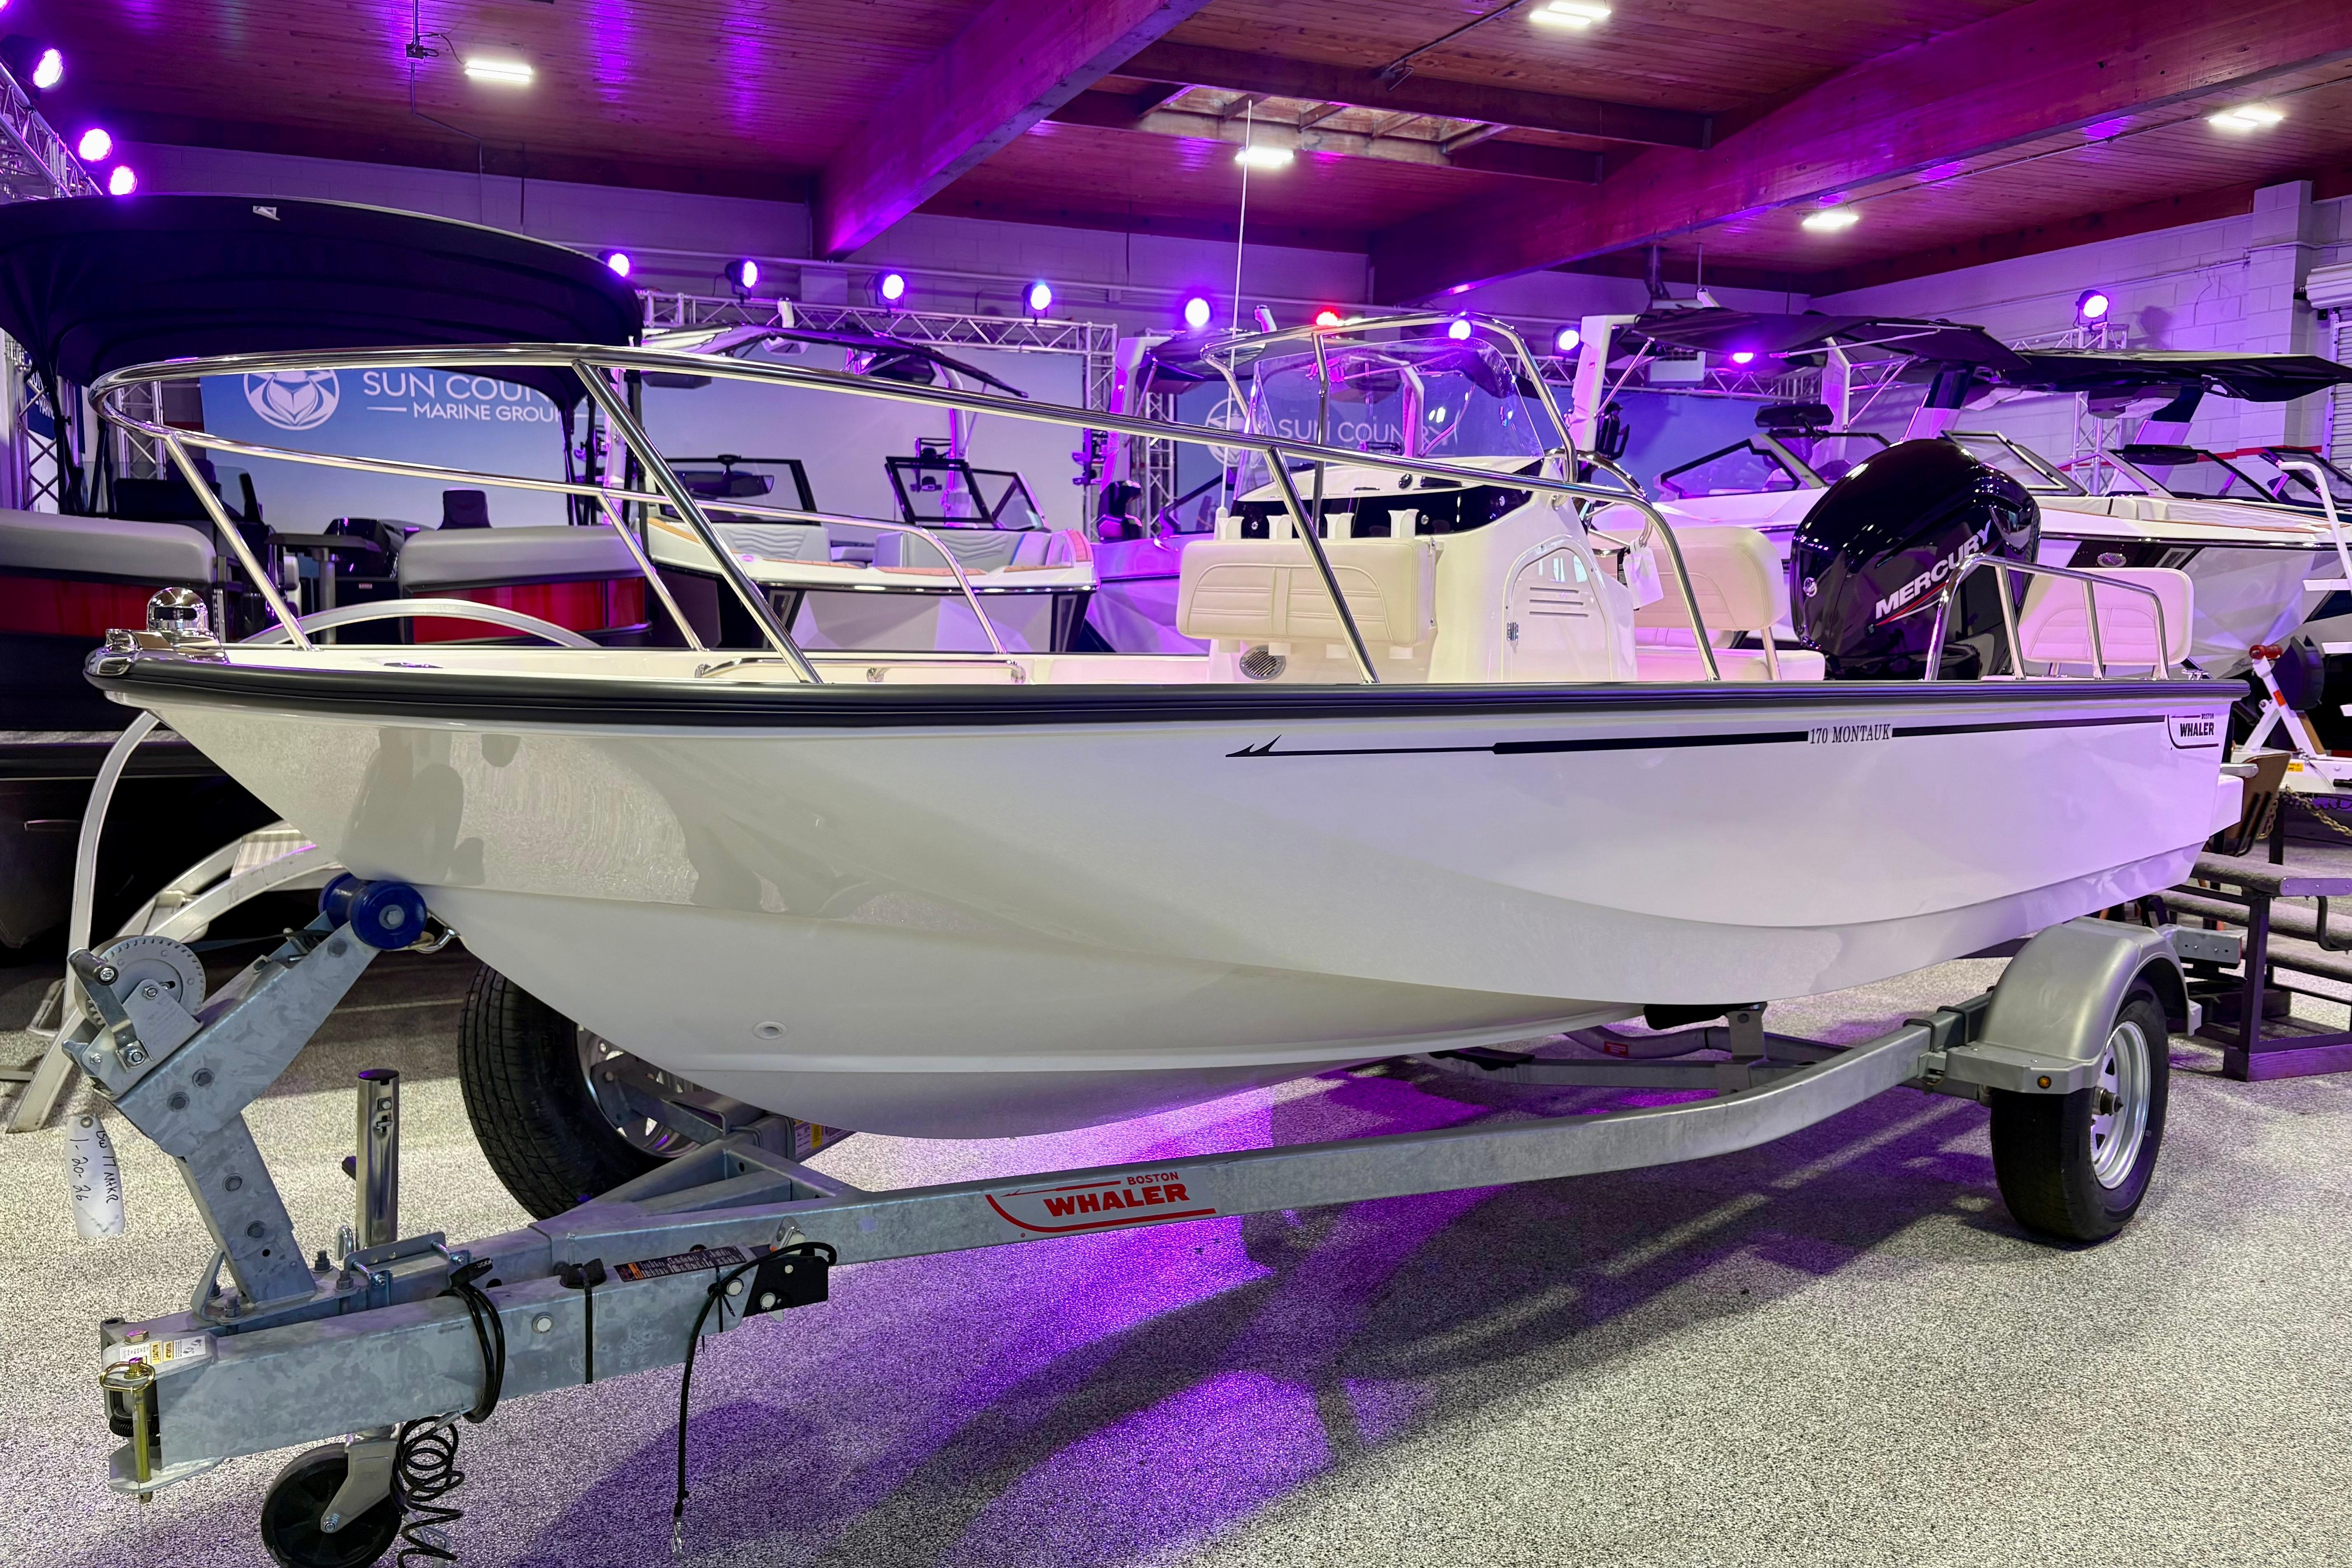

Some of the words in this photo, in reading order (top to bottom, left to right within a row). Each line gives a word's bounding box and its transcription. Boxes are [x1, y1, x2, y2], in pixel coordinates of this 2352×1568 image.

[363, 371, 435, 399] SUN
[413, 402, 490, 420] MARINE
[1876, 519, 1991, 619] MERCURY
[1810, 728, 1828, 744] 170
[1832, 723, 1890, 743] MONTAUK
[2180, 722, 2214, 737] WHALER
[103, 1156, 117, 1167] 17
[1127, 1172, 1179, 1185] BOSTON
[1043, 1183, 1190, 1217] WHALER
